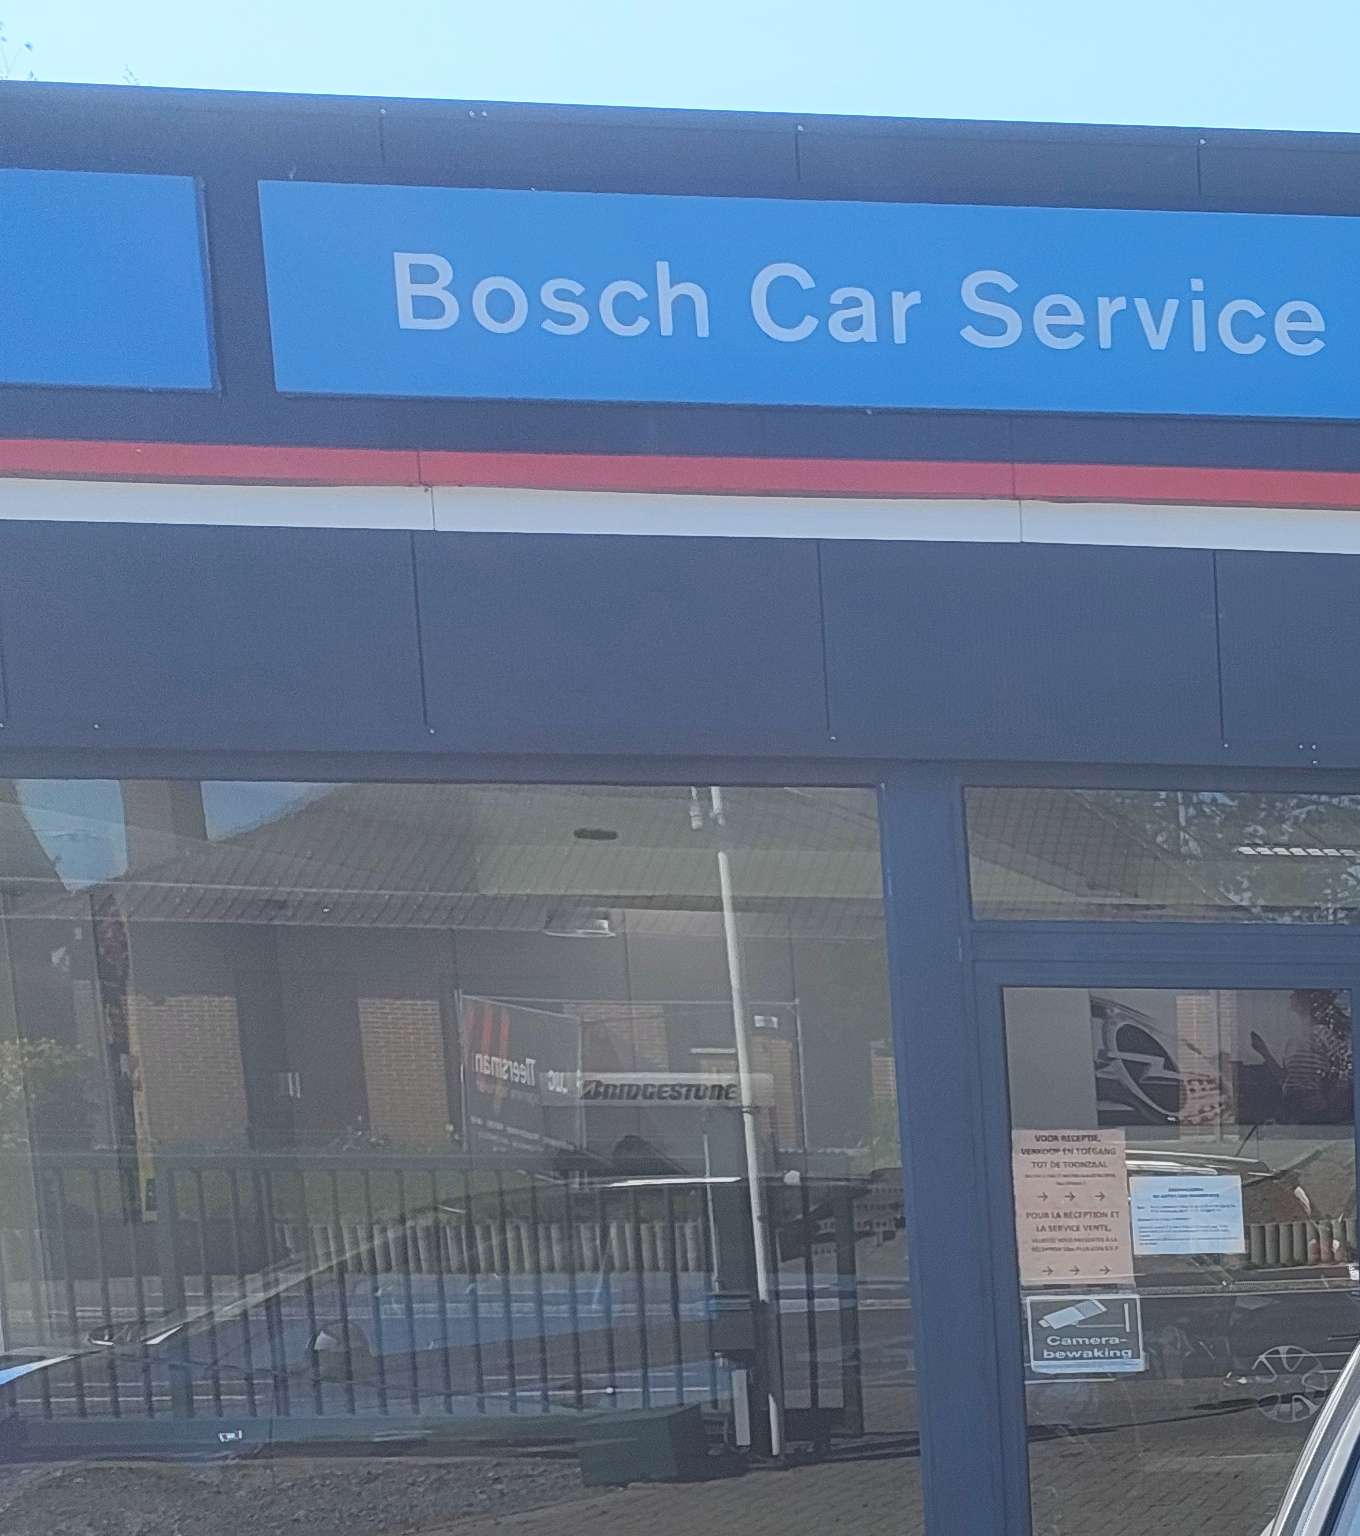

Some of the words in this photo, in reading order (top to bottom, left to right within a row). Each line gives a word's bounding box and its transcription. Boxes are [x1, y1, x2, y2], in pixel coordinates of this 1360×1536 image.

[392, 251, 711, 340] Bosch
[749, 262, 921, 345] Car
[958, 270, 1326, 356] Service
[580, 1079, 738, 1101] BRIDGESTONE
[1046, 1335, 1128, 1346] Camera-
[1043, 1347, 1132, 1360] bewaking
